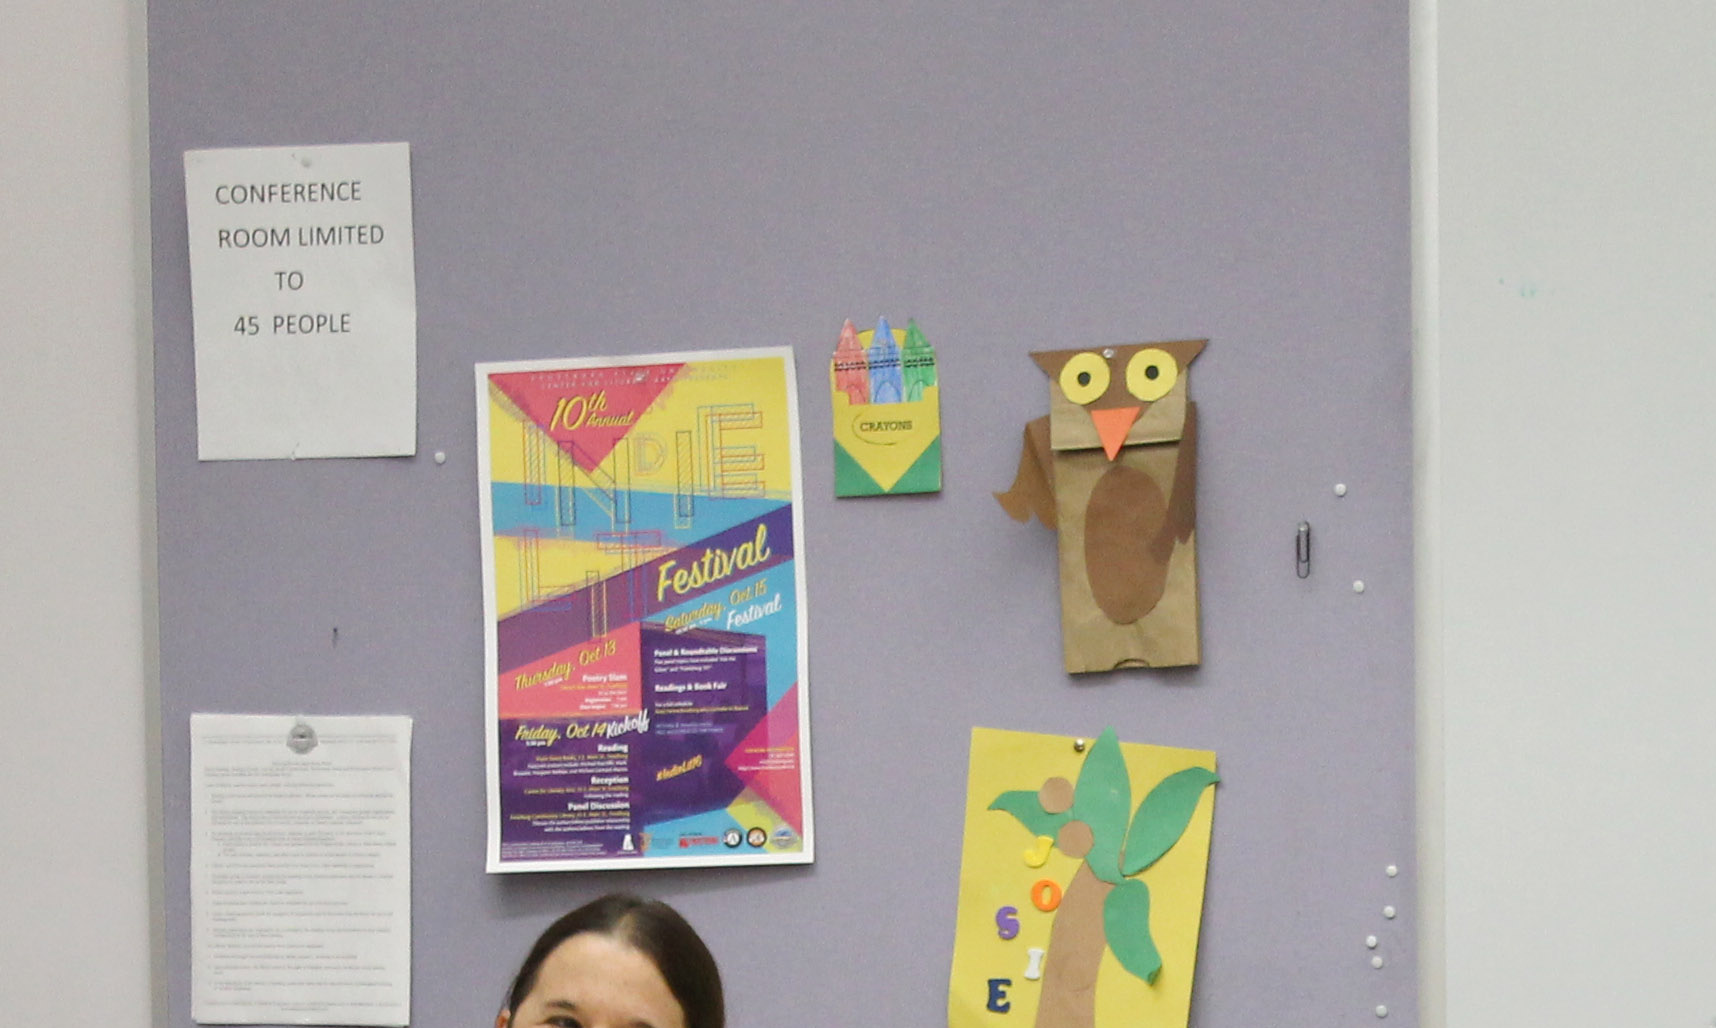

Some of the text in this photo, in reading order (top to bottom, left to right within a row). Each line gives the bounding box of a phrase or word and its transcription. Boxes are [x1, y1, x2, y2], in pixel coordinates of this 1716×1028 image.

[214, 181, 361, 204] CONFERENCE
[218, 224, 384, 248] ROOM LIMITED
[274, 271, 304, 290] TO
[234, 313, 351, 336] 45 PEOPLE
[586, 411, 635, 427] Annual
[860, 420, 913, 432] CRAYONS
[657, 523, 771, 602] Festival
[726, 592, 782, 630] Festival
[579, 645, 600, 666] Oct
[603, 639, 617, 657] 13
[566, 723, 590, 739] Oct
[591, 722, 607, 738] 14
[606, 708, 650, 739] Kickoff
